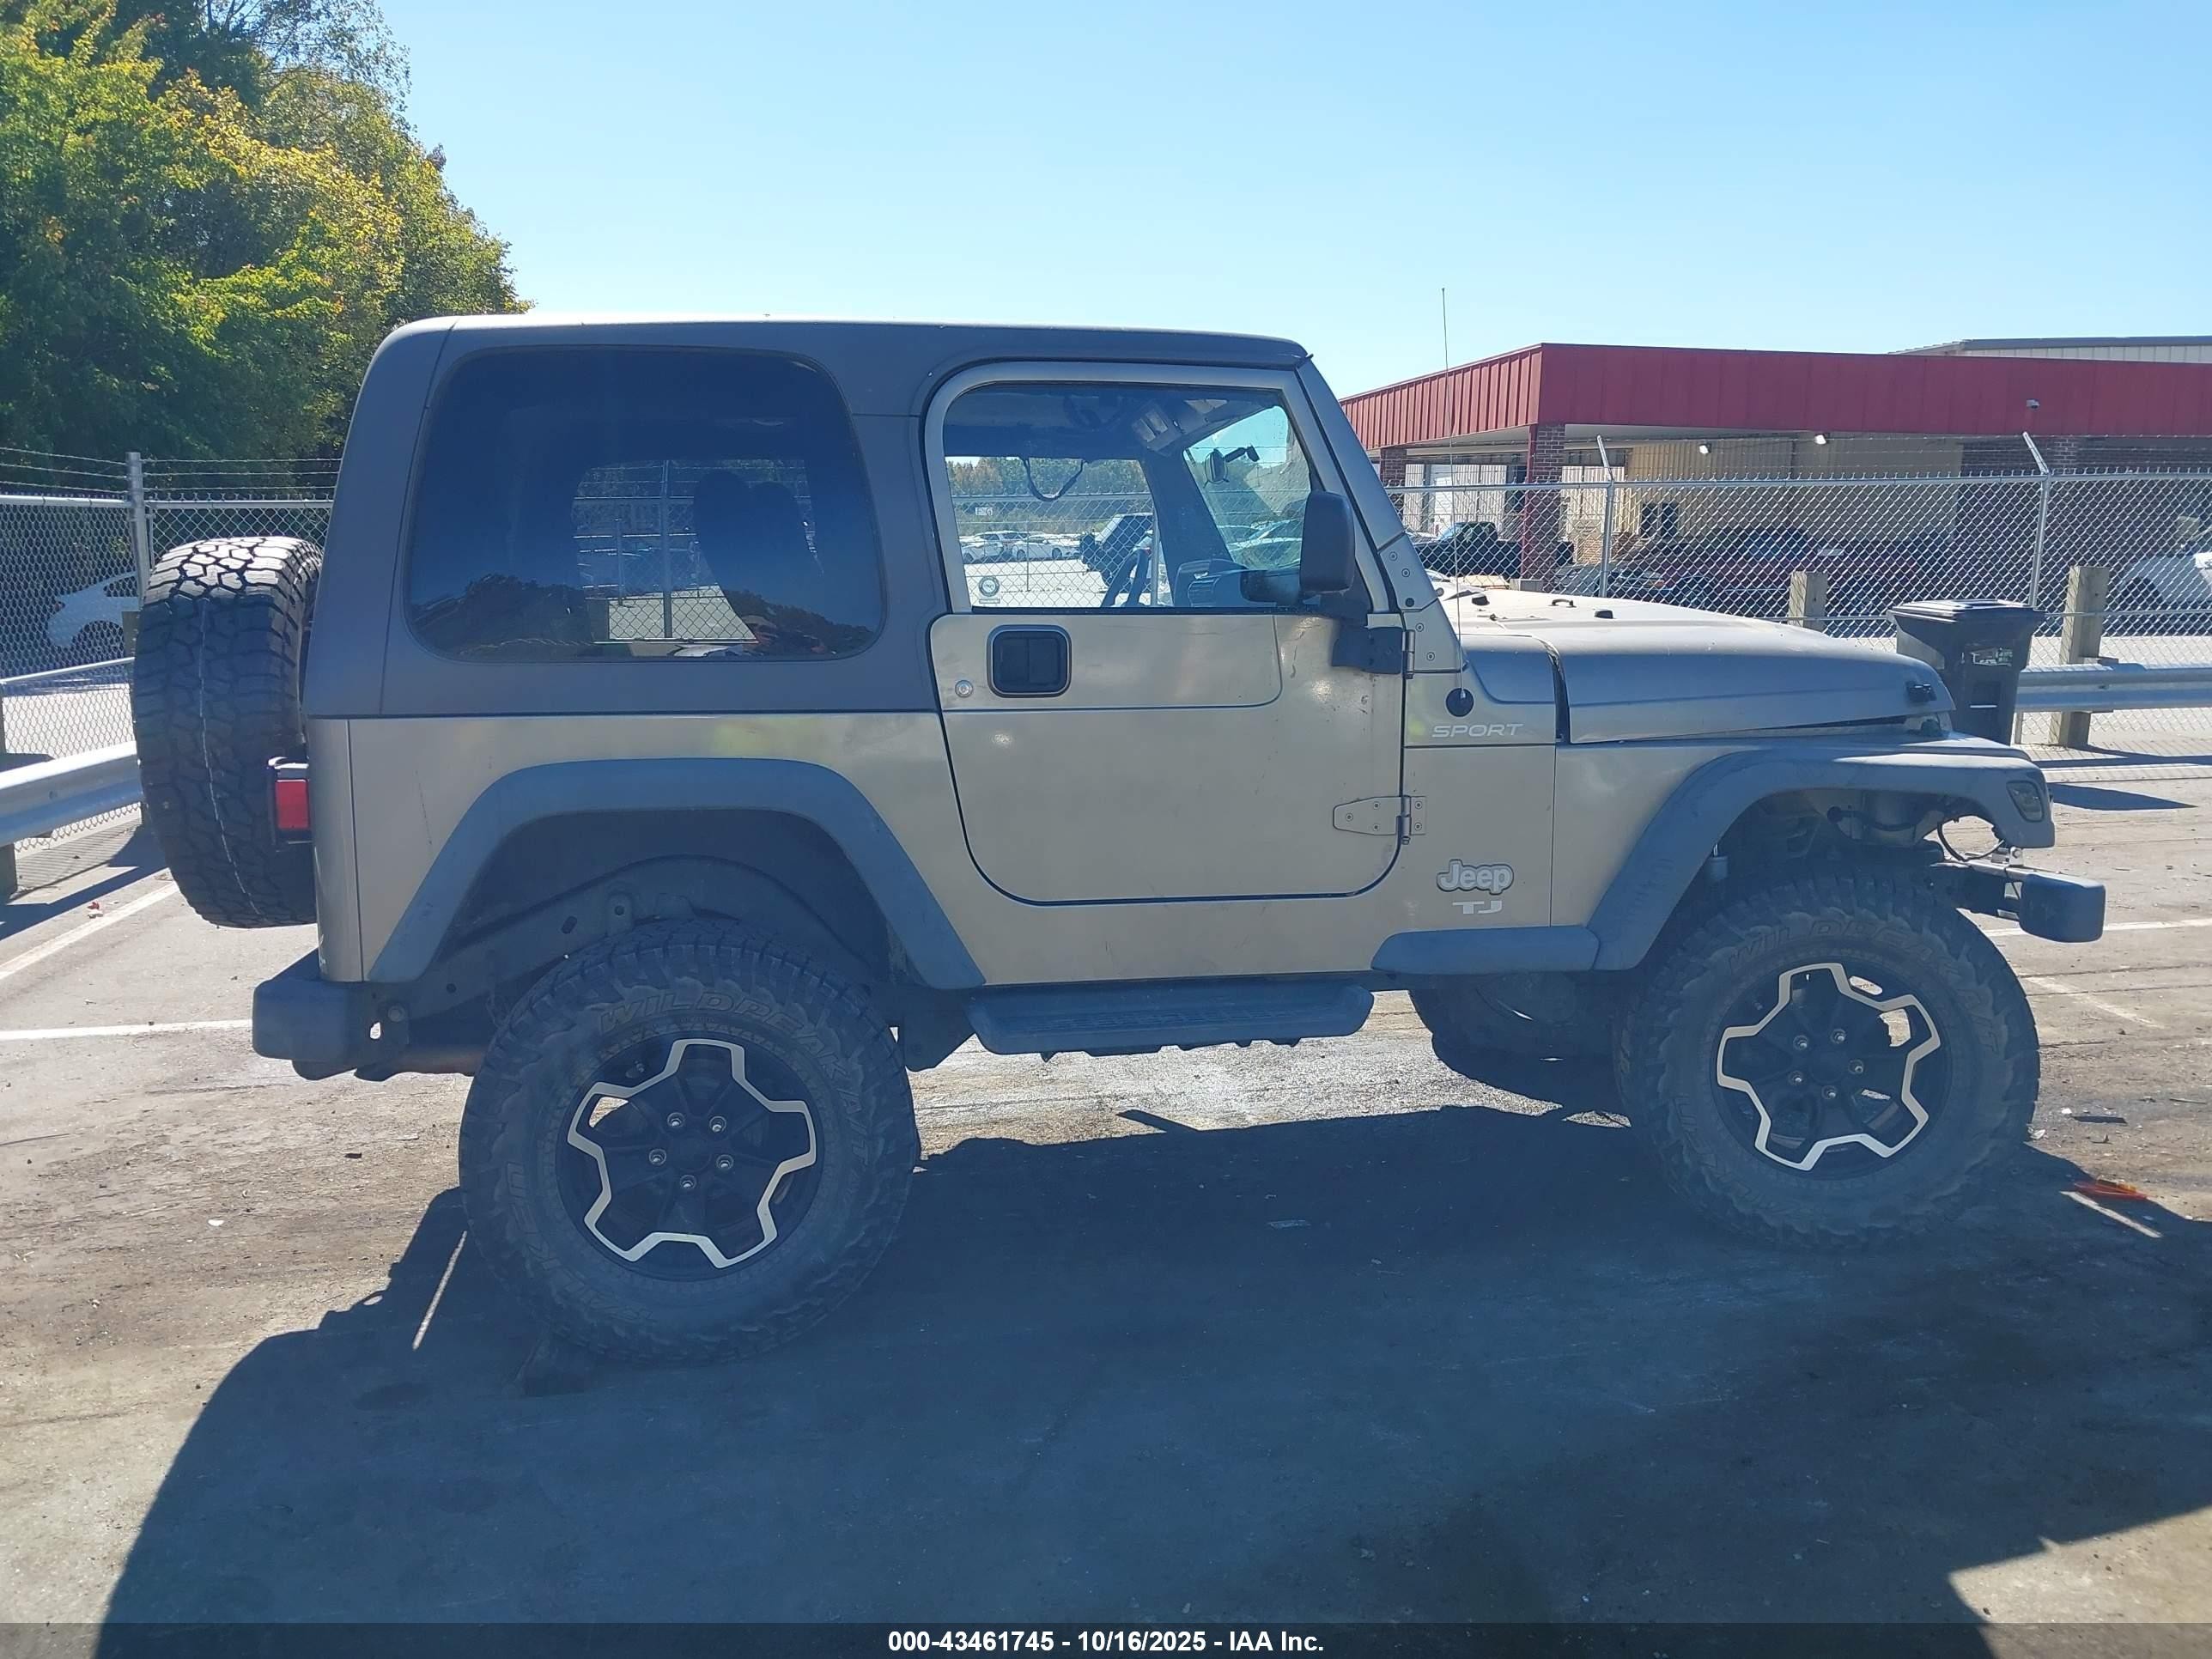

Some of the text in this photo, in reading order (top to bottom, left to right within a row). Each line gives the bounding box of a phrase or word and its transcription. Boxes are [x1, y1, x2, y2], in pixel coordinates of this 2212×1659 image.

[1431, 724, 1524, 738] SPORT
[1437, 859, 1515, 896] Jeep
[1452, 900, 1503, 915] TJ
[598, 990, 872, 1165] WILDPEAK A/T
